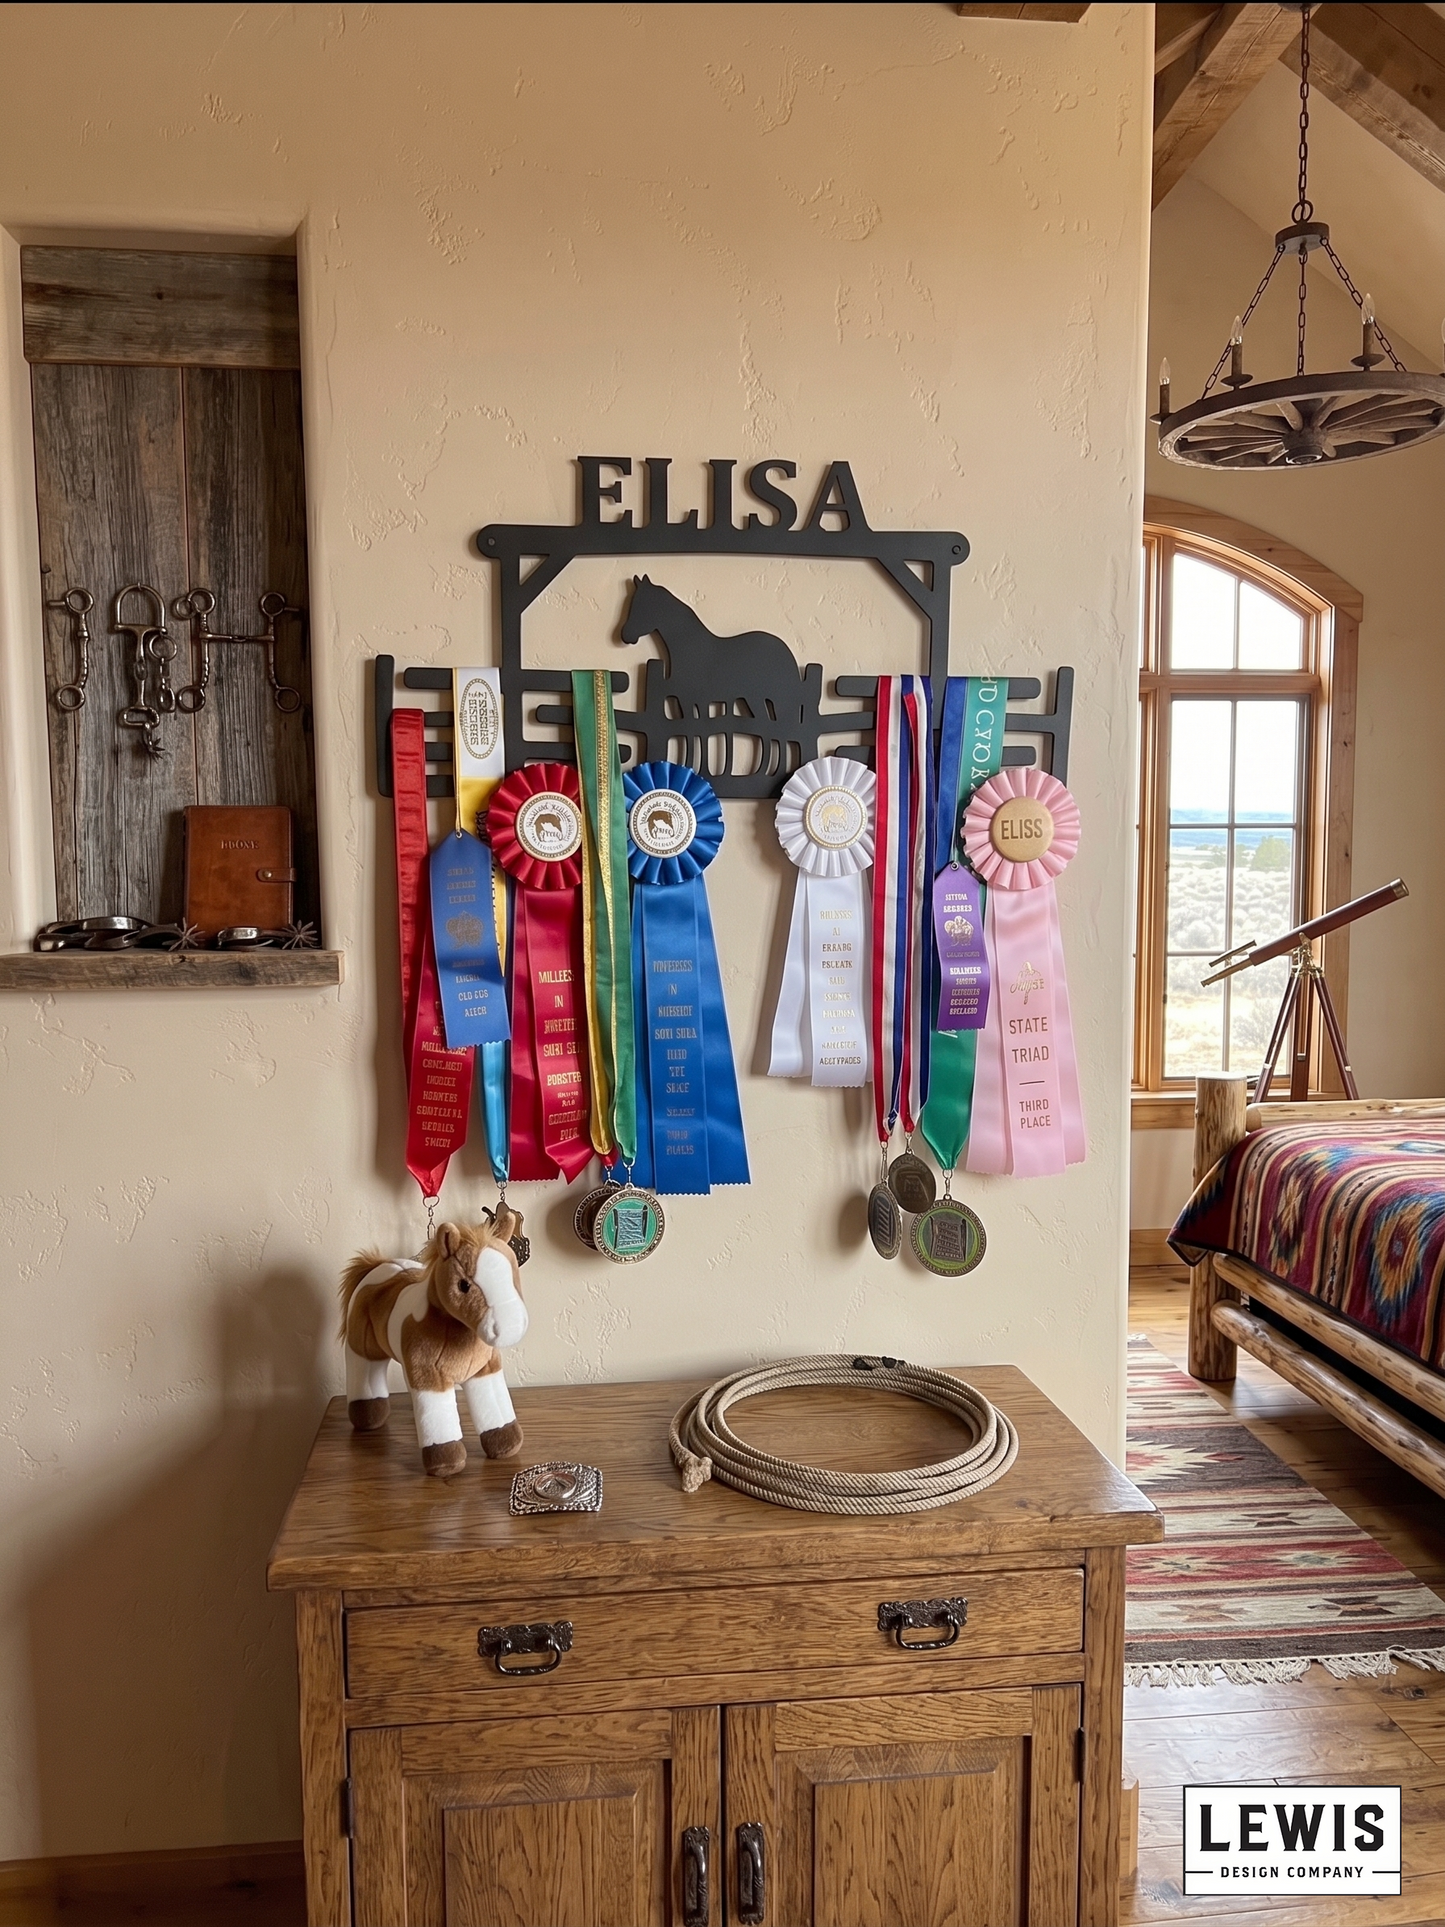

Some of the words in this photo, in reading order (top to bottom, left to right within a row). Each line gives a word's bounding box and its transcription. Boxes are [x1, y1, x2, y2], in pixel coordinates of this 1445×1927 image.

[577, 455, 871, 533] ELISA
[1001, 818, 1043, 840] ELISS
[1009, 1016, 1048, 1035] STATE
[1012, 1045, 1049, 1064] TRIAD
[1019, 1098, 1049, 1113] THIRD
[1020, 1115, 1051, 1130] PLACE
